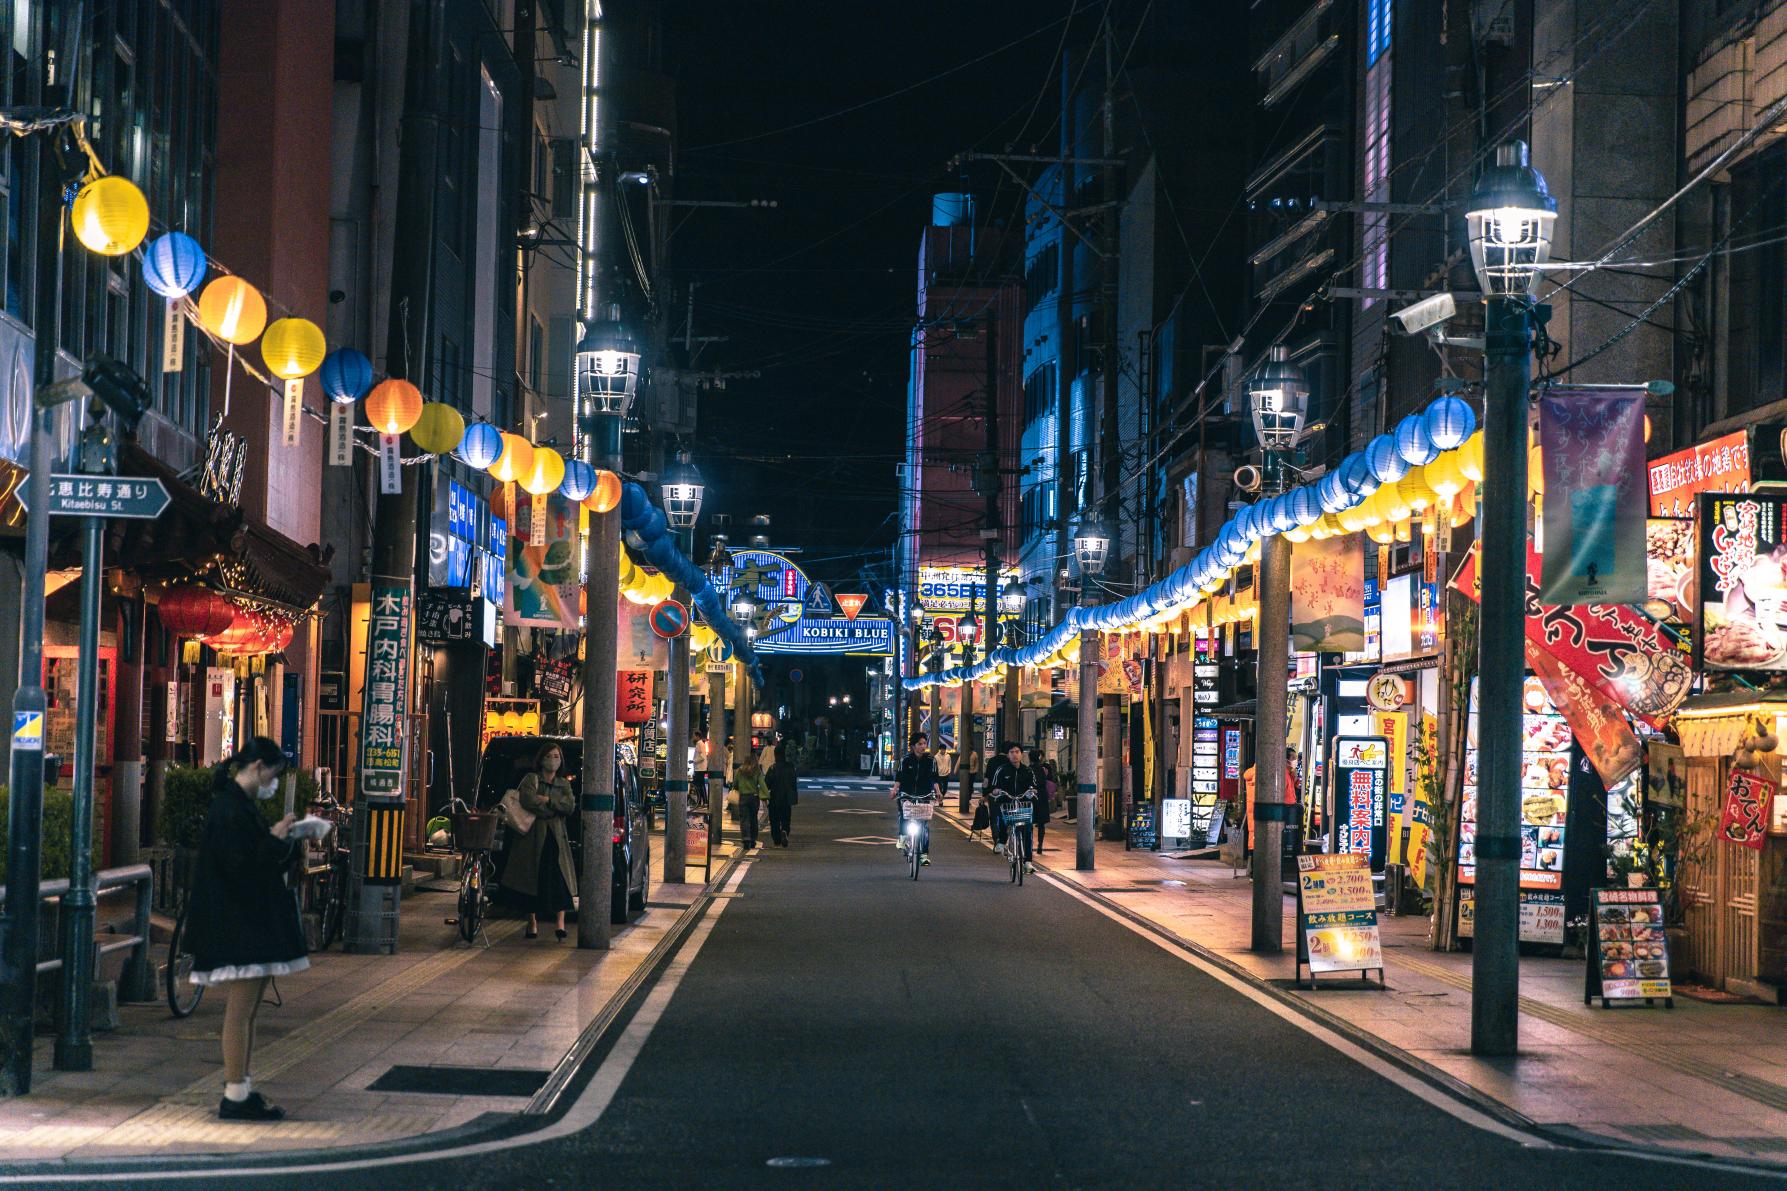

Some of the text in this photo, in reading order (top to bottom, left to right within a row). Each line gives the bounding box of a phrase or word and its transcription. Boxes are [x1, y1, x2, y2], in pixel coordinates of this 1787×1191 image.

[61, 499, 124, 510] Kitaebisu St.
[803, 628, 888, 638] KOBIKI BLUE
[368, 593, 400, 746] 木戸内科胃腸科
[626, 672, 648, 714] 研究所
[1731, 775, 1766, 833] おでん
[1309, 912, 1373, 924] 飲み放題コース
